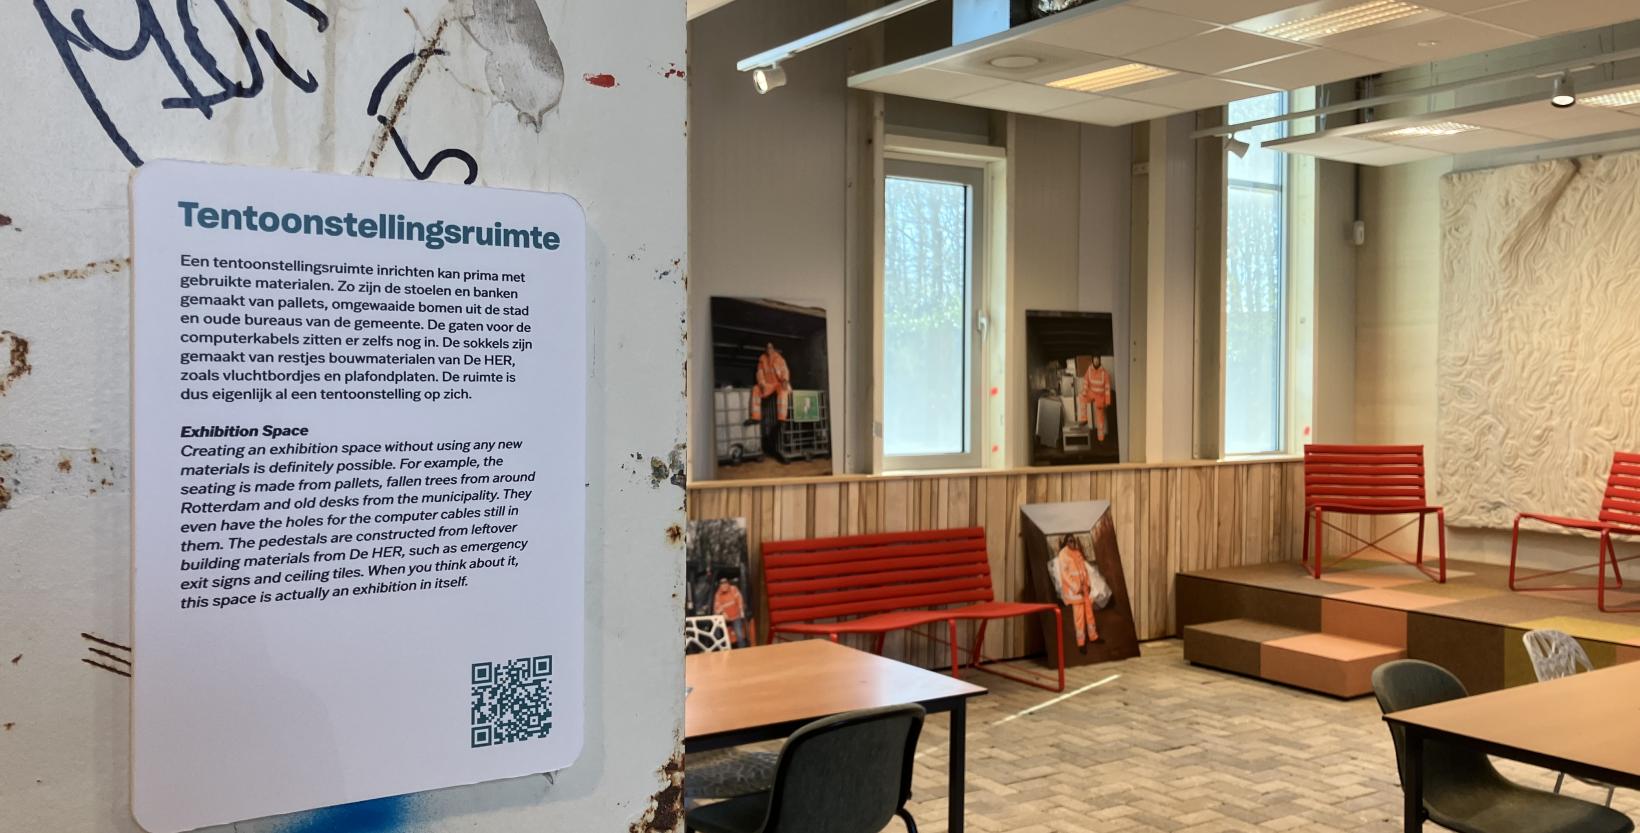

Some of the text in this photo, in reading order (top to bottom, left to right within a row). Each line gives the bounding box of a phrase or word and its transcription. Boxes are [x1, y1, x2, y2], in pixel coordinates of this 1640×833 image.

[178, 201, 560, 250] Tentoonstellingsruimte
[180, 254, 526, 283] Een tentoonstellingsruimte inrichten kan prima met
[179, 273, 519, 299] gebruikte materialen. Zo zijn de stoelen en banken
[179, 294, 529, 317] gemaakt van pallets, omgewaaide bomen uit de stad
[180, 312, 532, 334] en oude bureaus van de gemeente. De gaten voor de
[180, 332, 533, 352] computerkabels zitten er zelfs nog in. De sokkels zijn
[179, 350, 516, 368] gemaakt van restjes bouwmaterialen van De HER,
[180, 368, 516, 385] zoals vluchtbordjes en plafondplaten. De ruimte is
[180, 387, 472, 403] dus eigenlijk al een tentoonstelling op zich.
[180, 424, 310, 440] Exhibition Space
[180, 439, 523, 459] Creating an exhibition space without using any new
[180, 455, 504, 476] materials is definitely possible. For example, the
[180, 470, 537, 497] seating is made from pallets, fallen trees from around
[180, 488, 533, 515] Rotterdam and old desks from the municipality. They
[180, 504, 519, 534] even have the holes for the computer cables still in
[180, 522, 519, 553] them. The pedestals are constructed from leftover
[180, 540, 529, 571] building materials from De HER, such as emergency
[180, 554, 519, 590] exit signs and ceiling tiles. When you think about it,
[180, 575, 469, 610] this space is actually an exhibition in itself.
